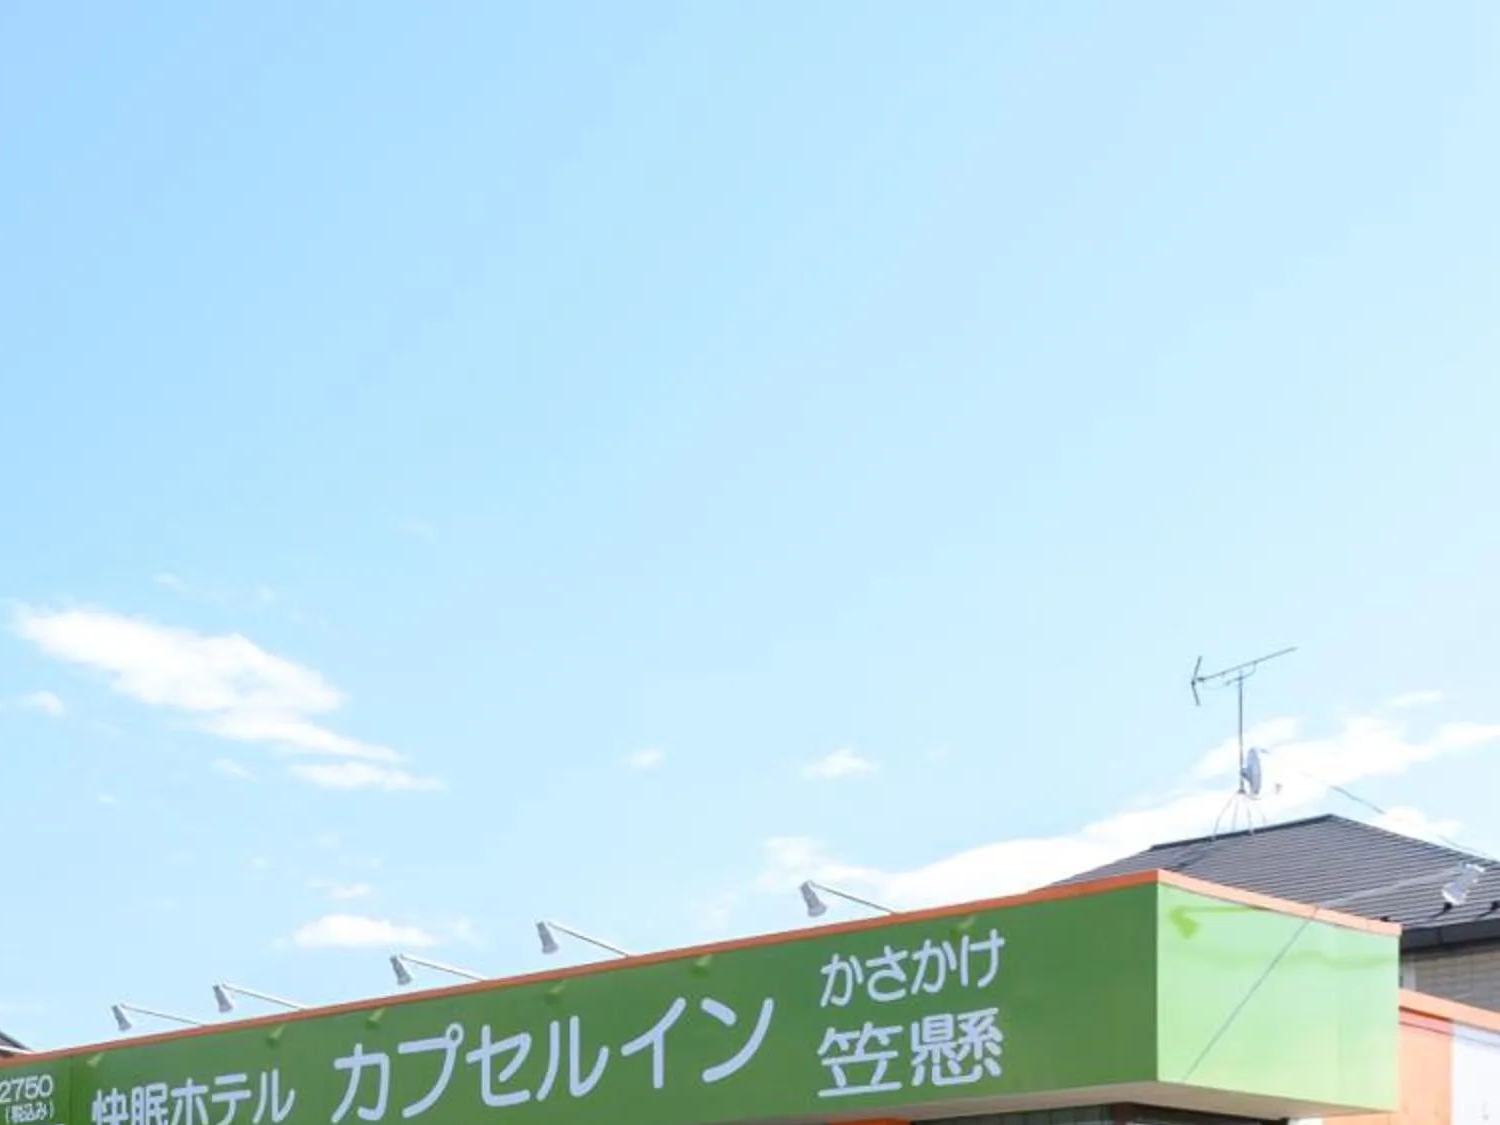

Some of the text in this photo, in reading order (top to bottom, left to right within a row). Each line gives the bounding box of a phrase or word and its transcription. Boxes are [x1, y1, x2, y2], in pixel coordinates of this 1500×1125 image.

[819, 928, 1006, 1008] かさかけ
[329, 995, 776, 1125] カプセルイン
[817, 1007, 1004, 1098] 笠懸
